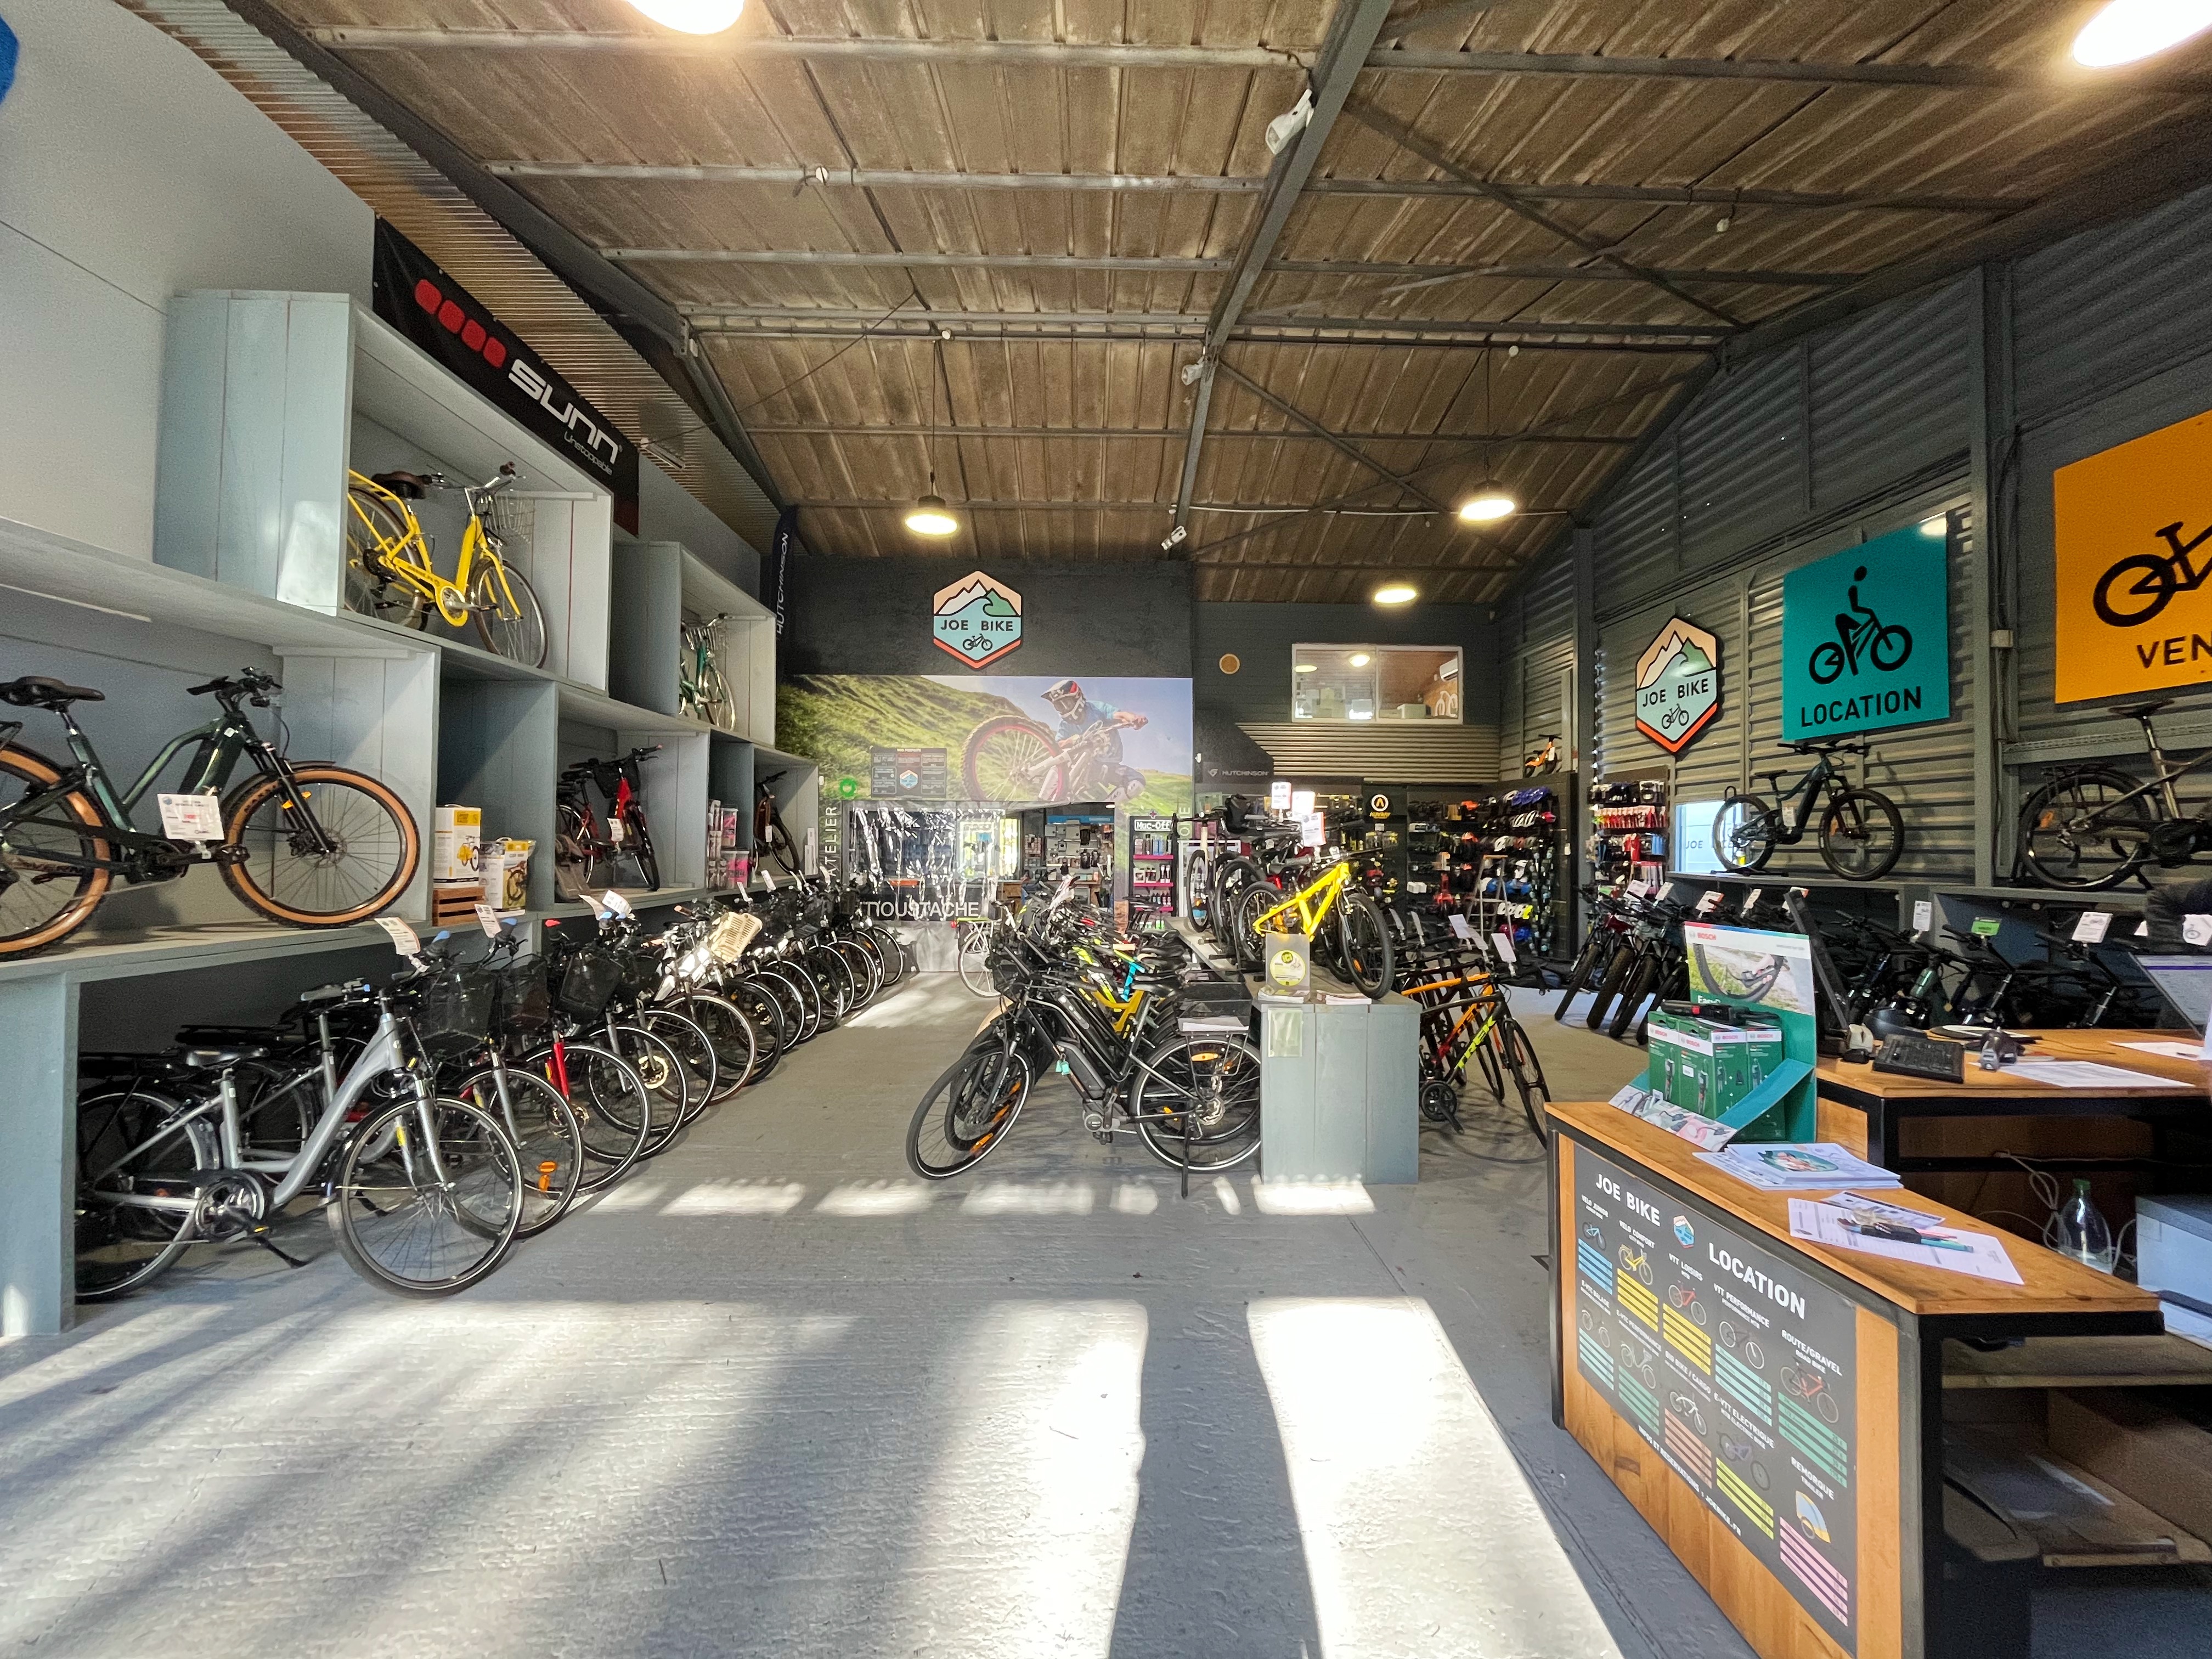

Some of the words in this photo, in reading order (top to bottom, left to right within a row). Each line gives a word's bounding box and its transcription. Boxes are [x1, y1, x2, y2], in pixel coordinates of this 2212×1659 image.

[564, 431, 613, 475] Unstoppable
[777, 532, 788, 634] HUTCHINSON
[941, 619, 968, 630] JOE
[981, 620, 1013, 631] BIKE
[1643, 689, 1666, 707] JOE
[1678, 678, 1709, 698] BIKE
[1801, 686, 1921, 727] LOCATION
[825, 806, 837, 876] ATELIER
[1136, 821, 1171, 830] Muc-Off
[1686, 840, 1703, 849] JOE
[1596, 1173, 1621, 1201] JOE
[1626, 1192, 1661, 1227] BIKE
[1669, 1253, 1678, 1265] VTT
[1708, 1242, 1805, 1319] LOCATION
[1714, 1283, 1724, 1296] VTT
[1726, 1291, 1769, 1328] PERFORMANCE
[1782, 1328, 1842, 1377] ROUTE/GRAVEL
[1714, 1391, 1731, 1413] E-VTT
[1733, 1407, 1774, 1449] ELECTRIQUE
[1791, 1456, 1834, 1500] REMORQUE
